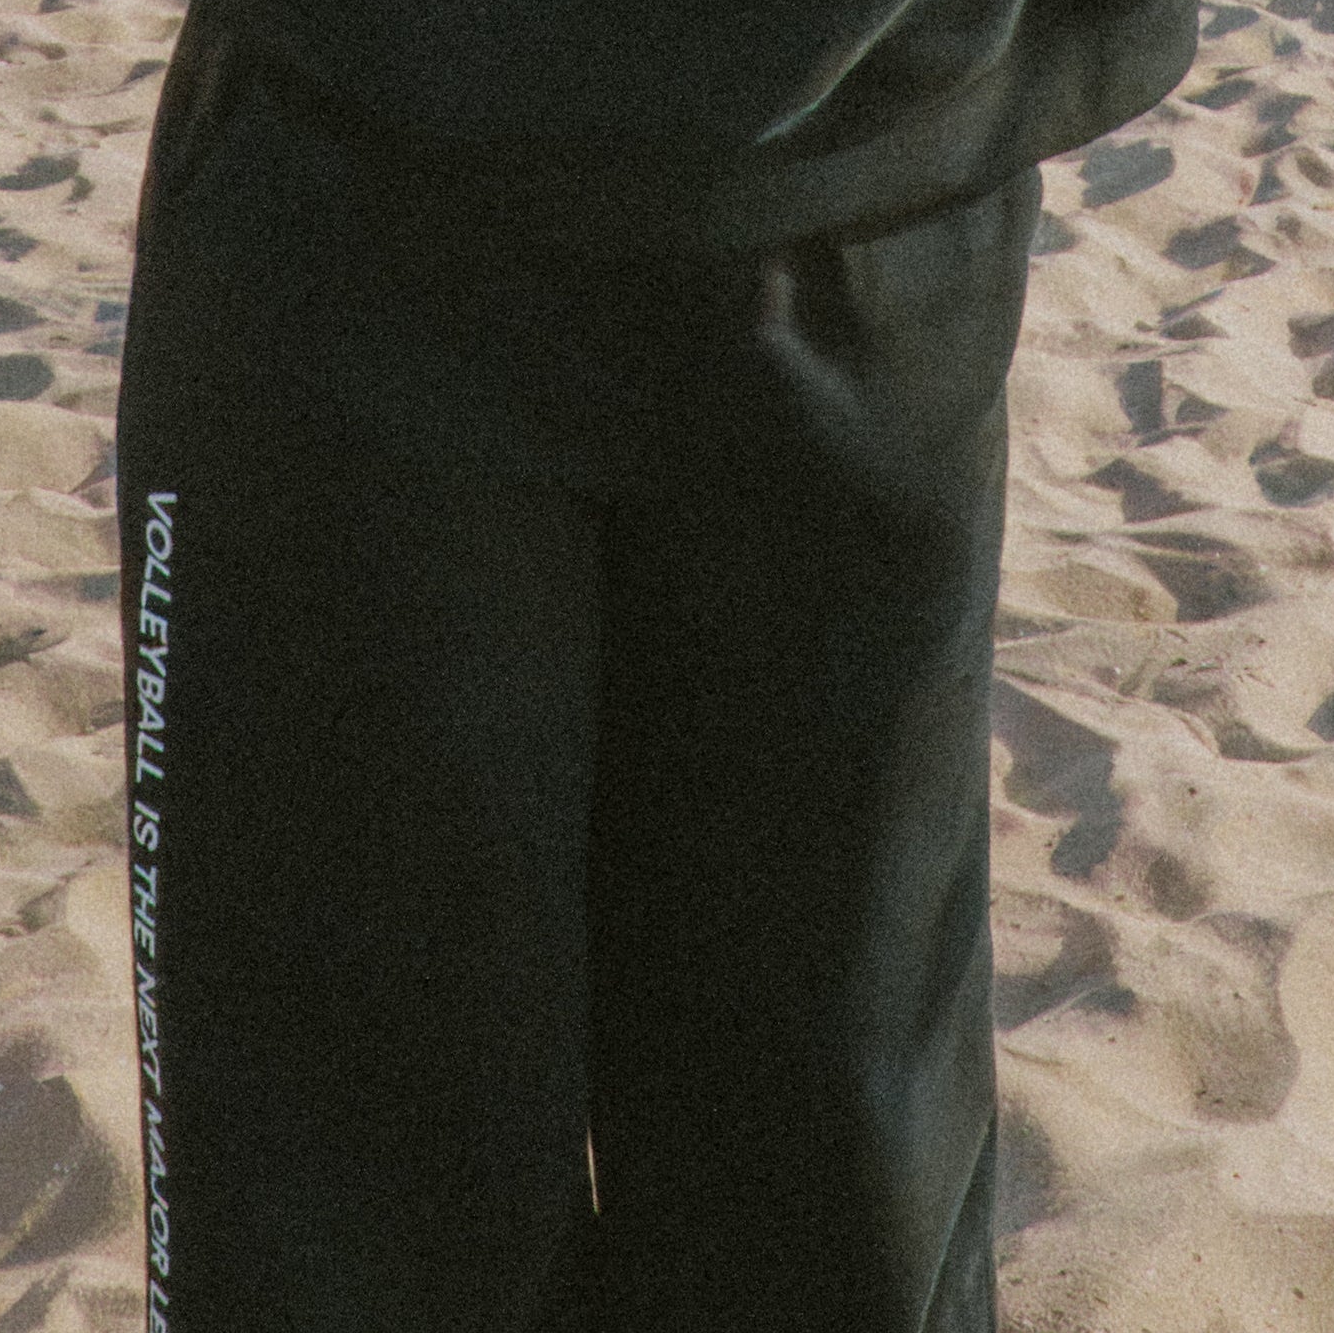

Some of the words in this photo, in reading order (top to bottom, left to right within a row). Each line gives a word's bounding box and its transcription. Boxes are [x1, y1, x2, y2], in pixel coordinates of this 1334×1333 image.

[136, 491, 178, 783] VOLLEYBALL
[133, 799, 160, 853] IS
[134, 863, 157, 958] THE
[136, 962, 161, 1096] NEXT
[144, 1098, 170, 1276] MAJOR
